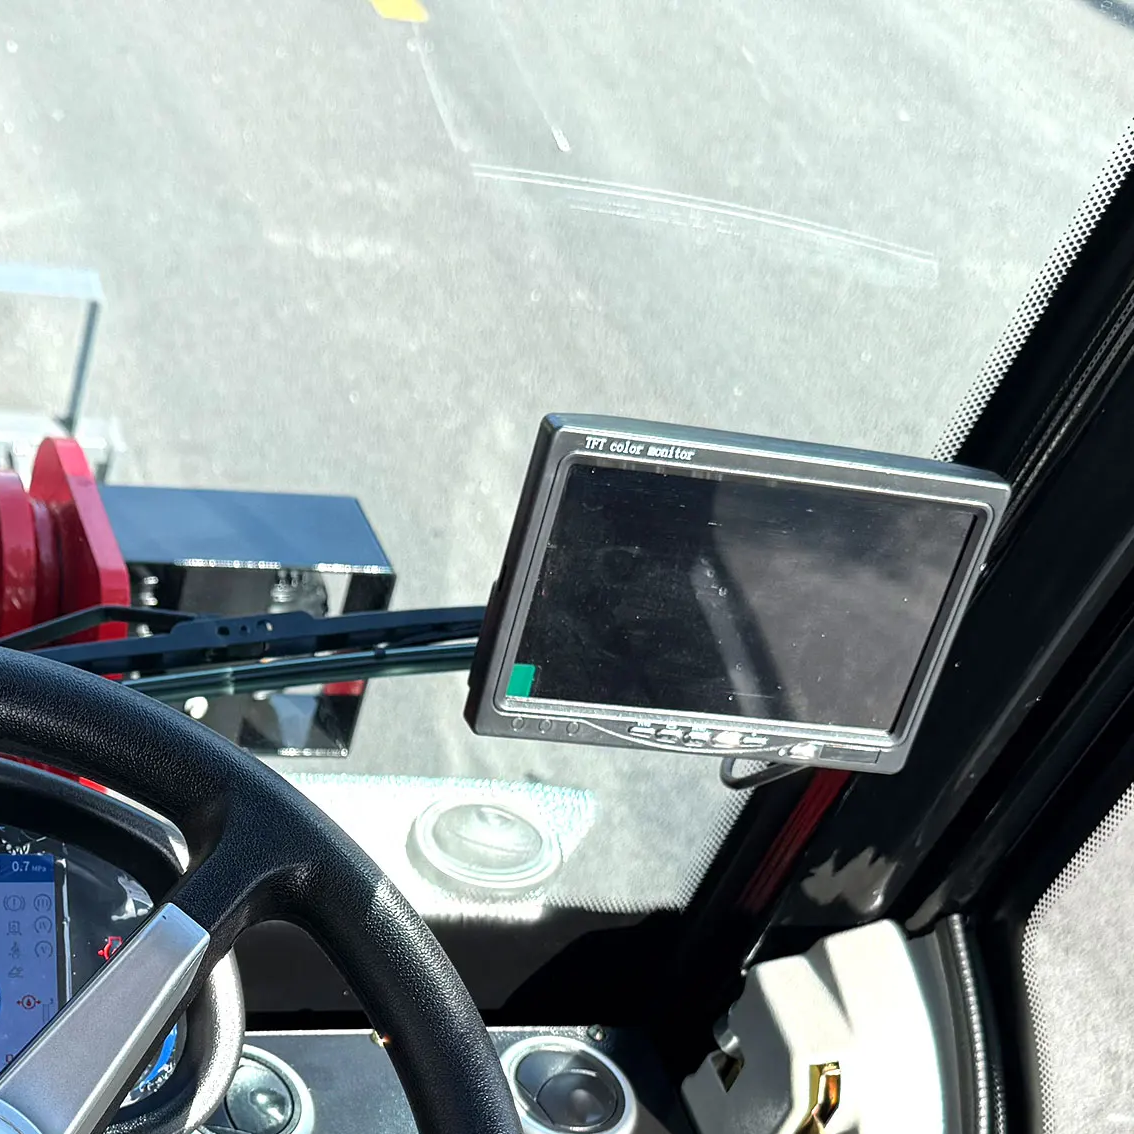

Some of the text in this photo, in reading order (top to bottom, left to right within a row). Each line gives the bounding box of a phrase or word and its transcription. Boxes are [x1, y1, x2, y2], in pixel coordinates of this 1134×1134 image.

[585, 436, 696, 461] TFT color monitor
[12, 860, 31, 872] 0.7
